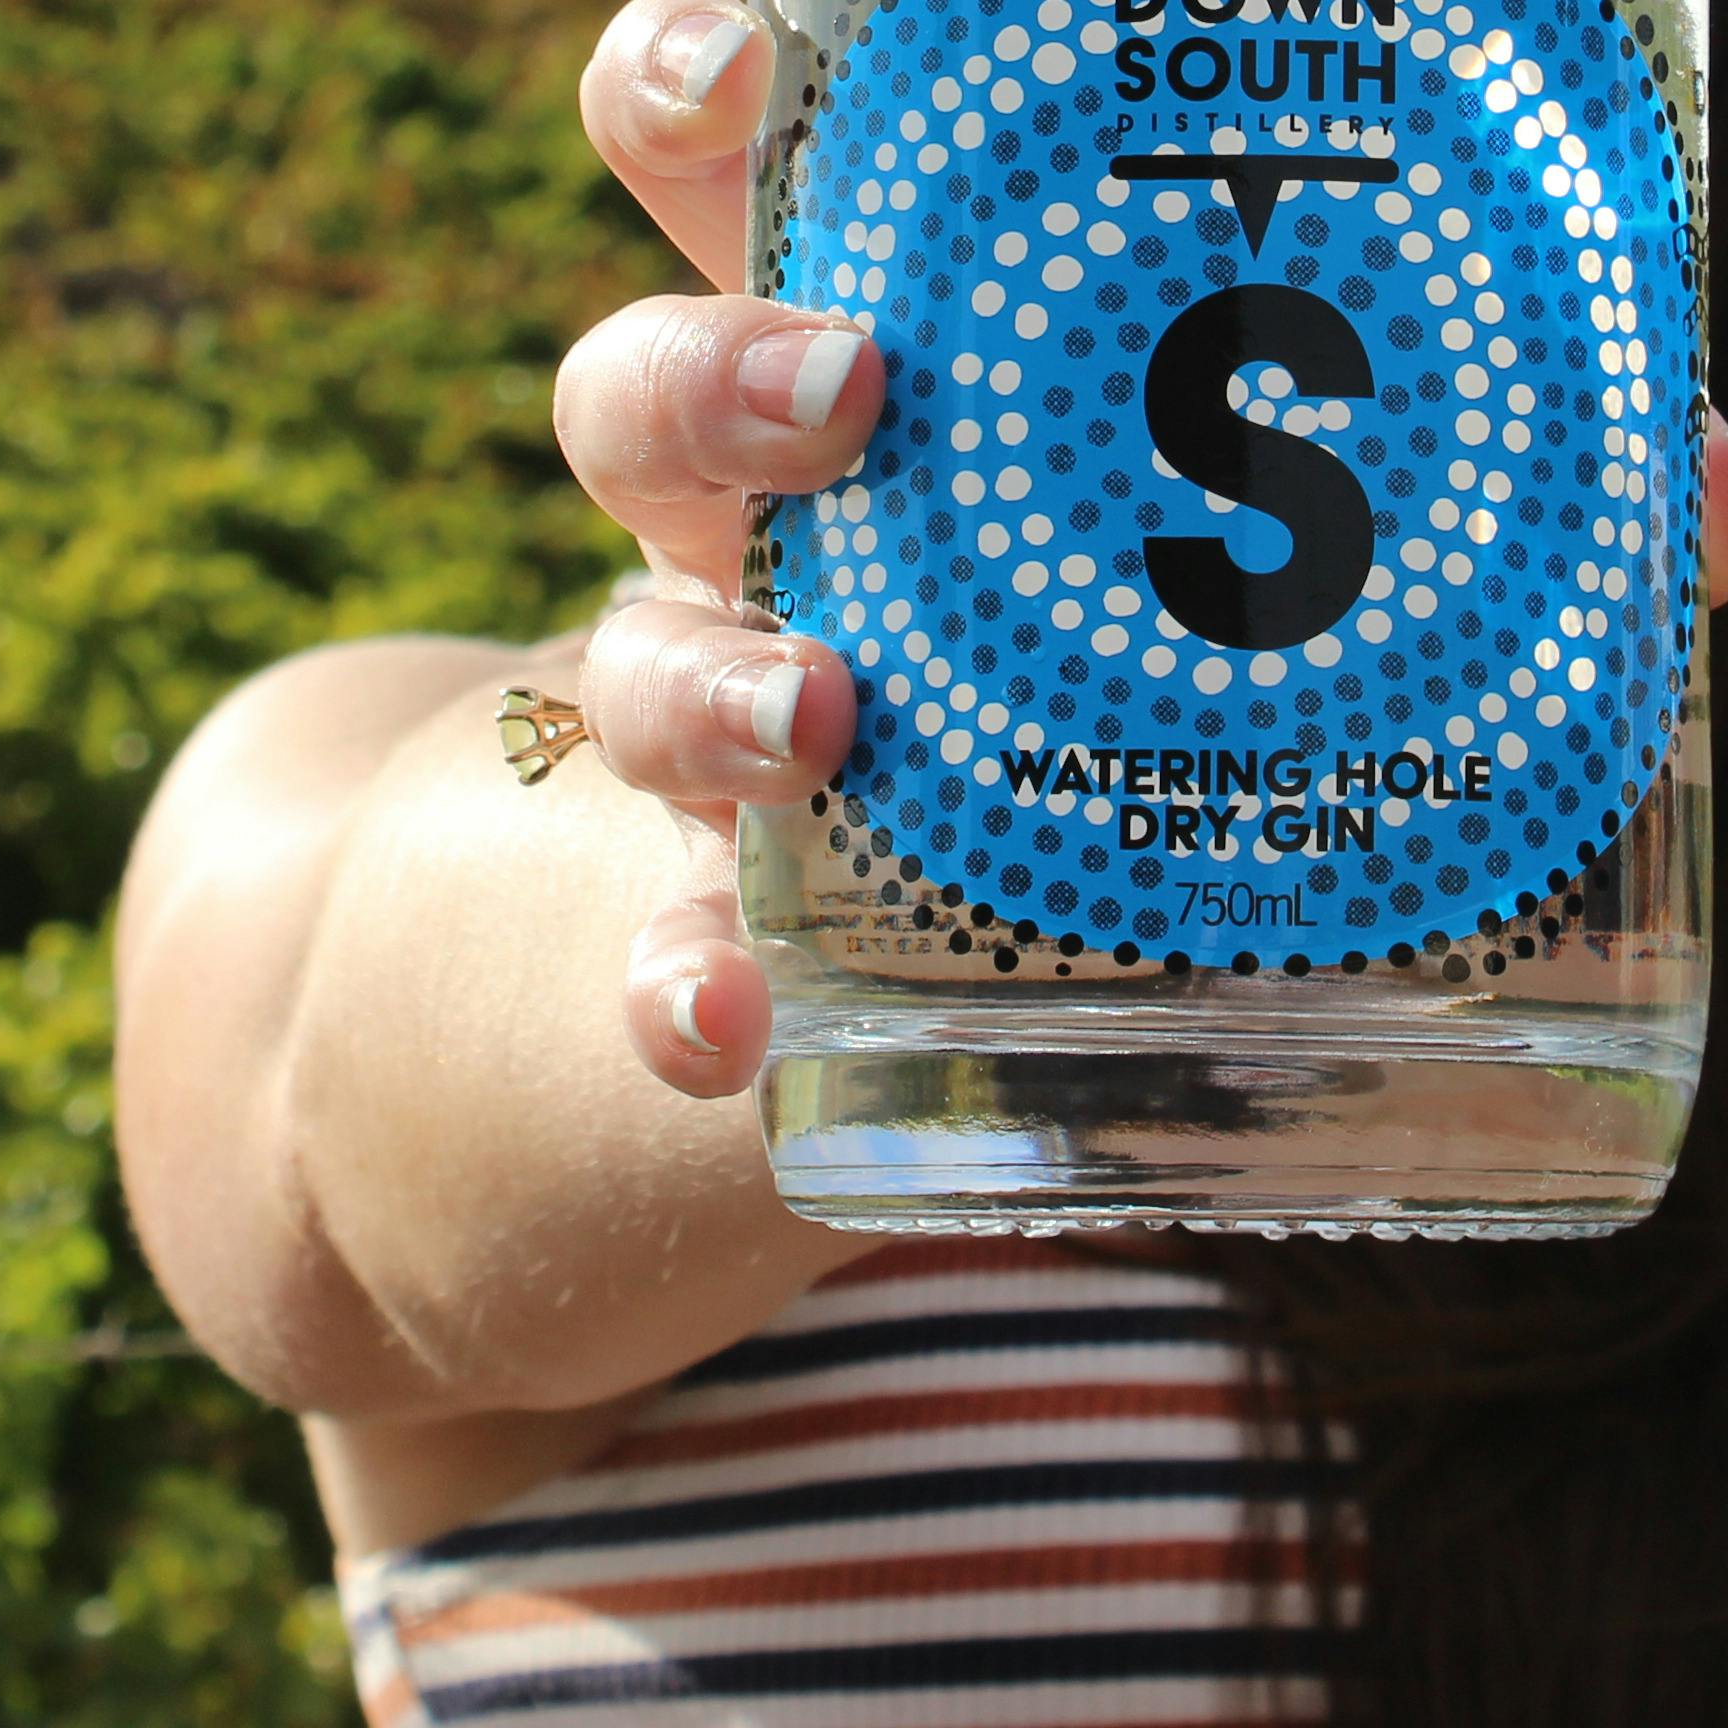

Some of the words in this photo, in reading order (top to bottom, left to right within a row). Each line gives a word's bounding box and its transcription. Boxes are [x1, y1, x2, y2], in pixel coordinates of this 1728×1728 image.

[1114, 36, 1396, 104] SOUTH
[1117, 112, 1395, 136] DISTILLERY
[1142, 282, 1376, 652] S
[999, 747, 1313, 798] WATERING
[1335, 750, 1494, 803] HOLE
[1118, 804, 1241, 852] DRY
[1260, 803, 1374, 853] GIN
[1174, 881, 1318, 928] 750mL
